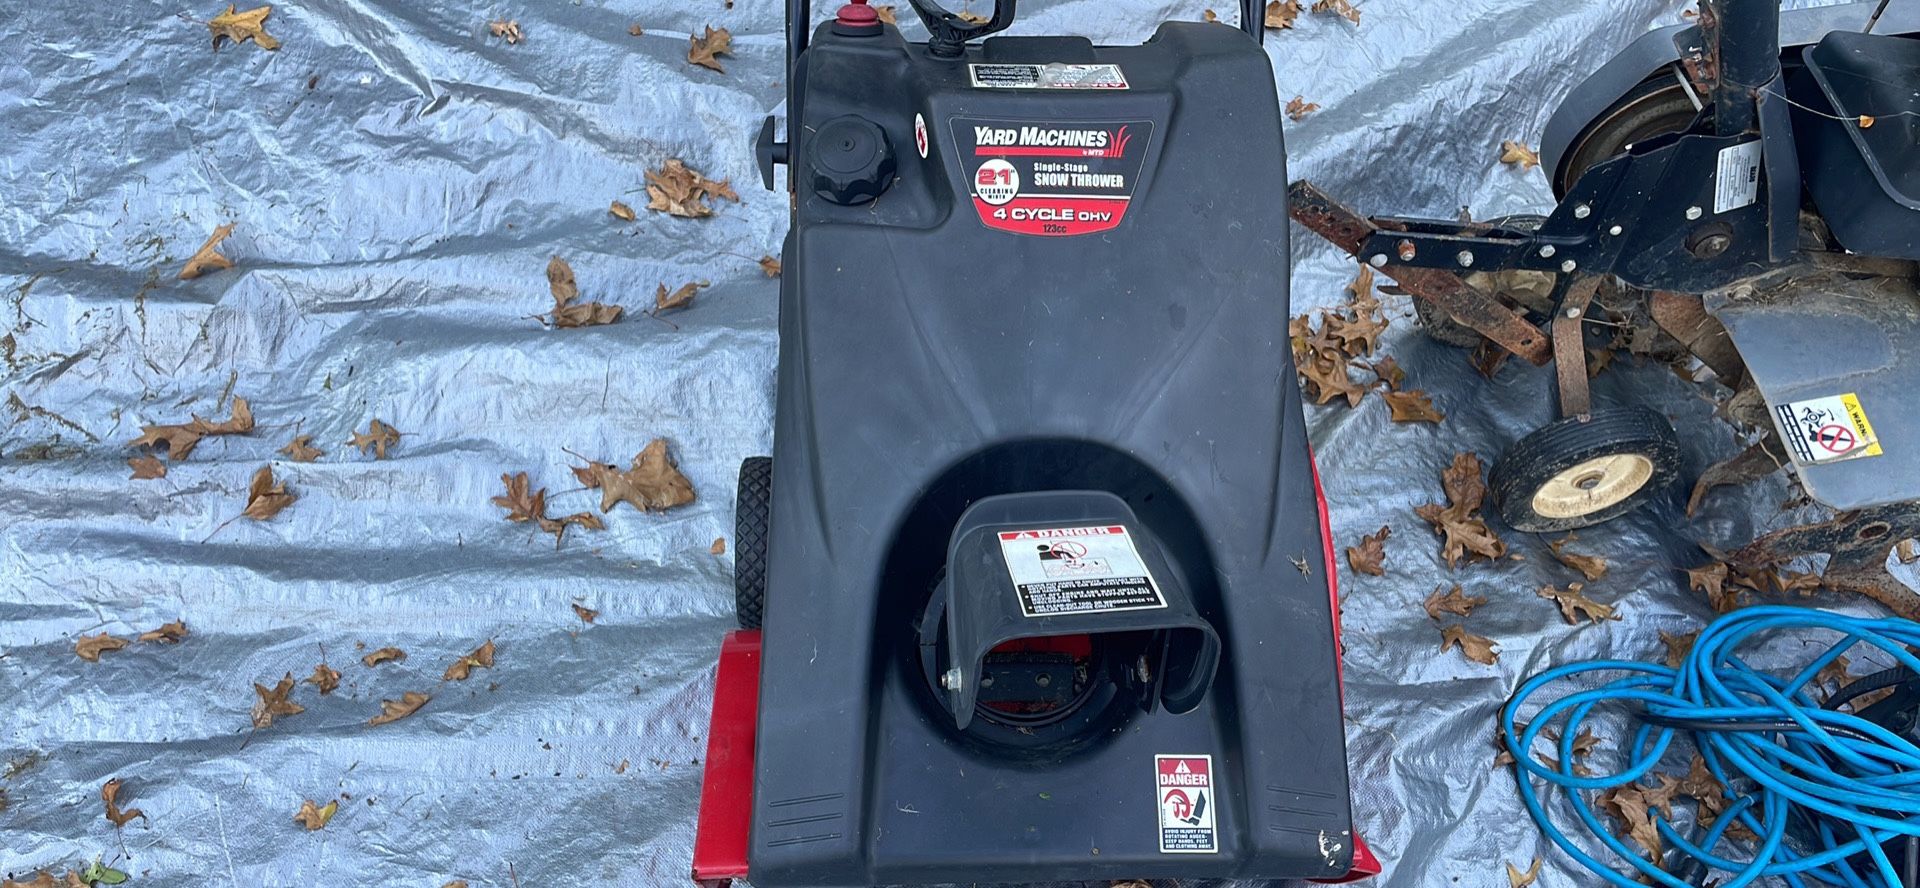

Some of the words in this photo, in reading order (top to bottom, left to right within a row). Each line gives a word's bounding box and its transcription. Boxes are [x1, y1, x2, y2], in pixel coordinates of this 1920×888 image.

[974, 126, 1017, 146] YARD
[1019, 126, 1107, 147] MACHINES
[1034, 162, 1088, 173] Single-Stage
[1034, 174, 1070, 186] SNOW
[1071, 174, 1124, 187] THROWER
[993, 208, 1007, 220] 4
[1011, 208, 1074, 221] CYCLE
[1078, 211, 1111, 221] OHV
[1043, 224, 1067, 233] 123cc
[1038, 527, 1107, 538] DANGER
[1160, 774, 1207, 785] DANGER
